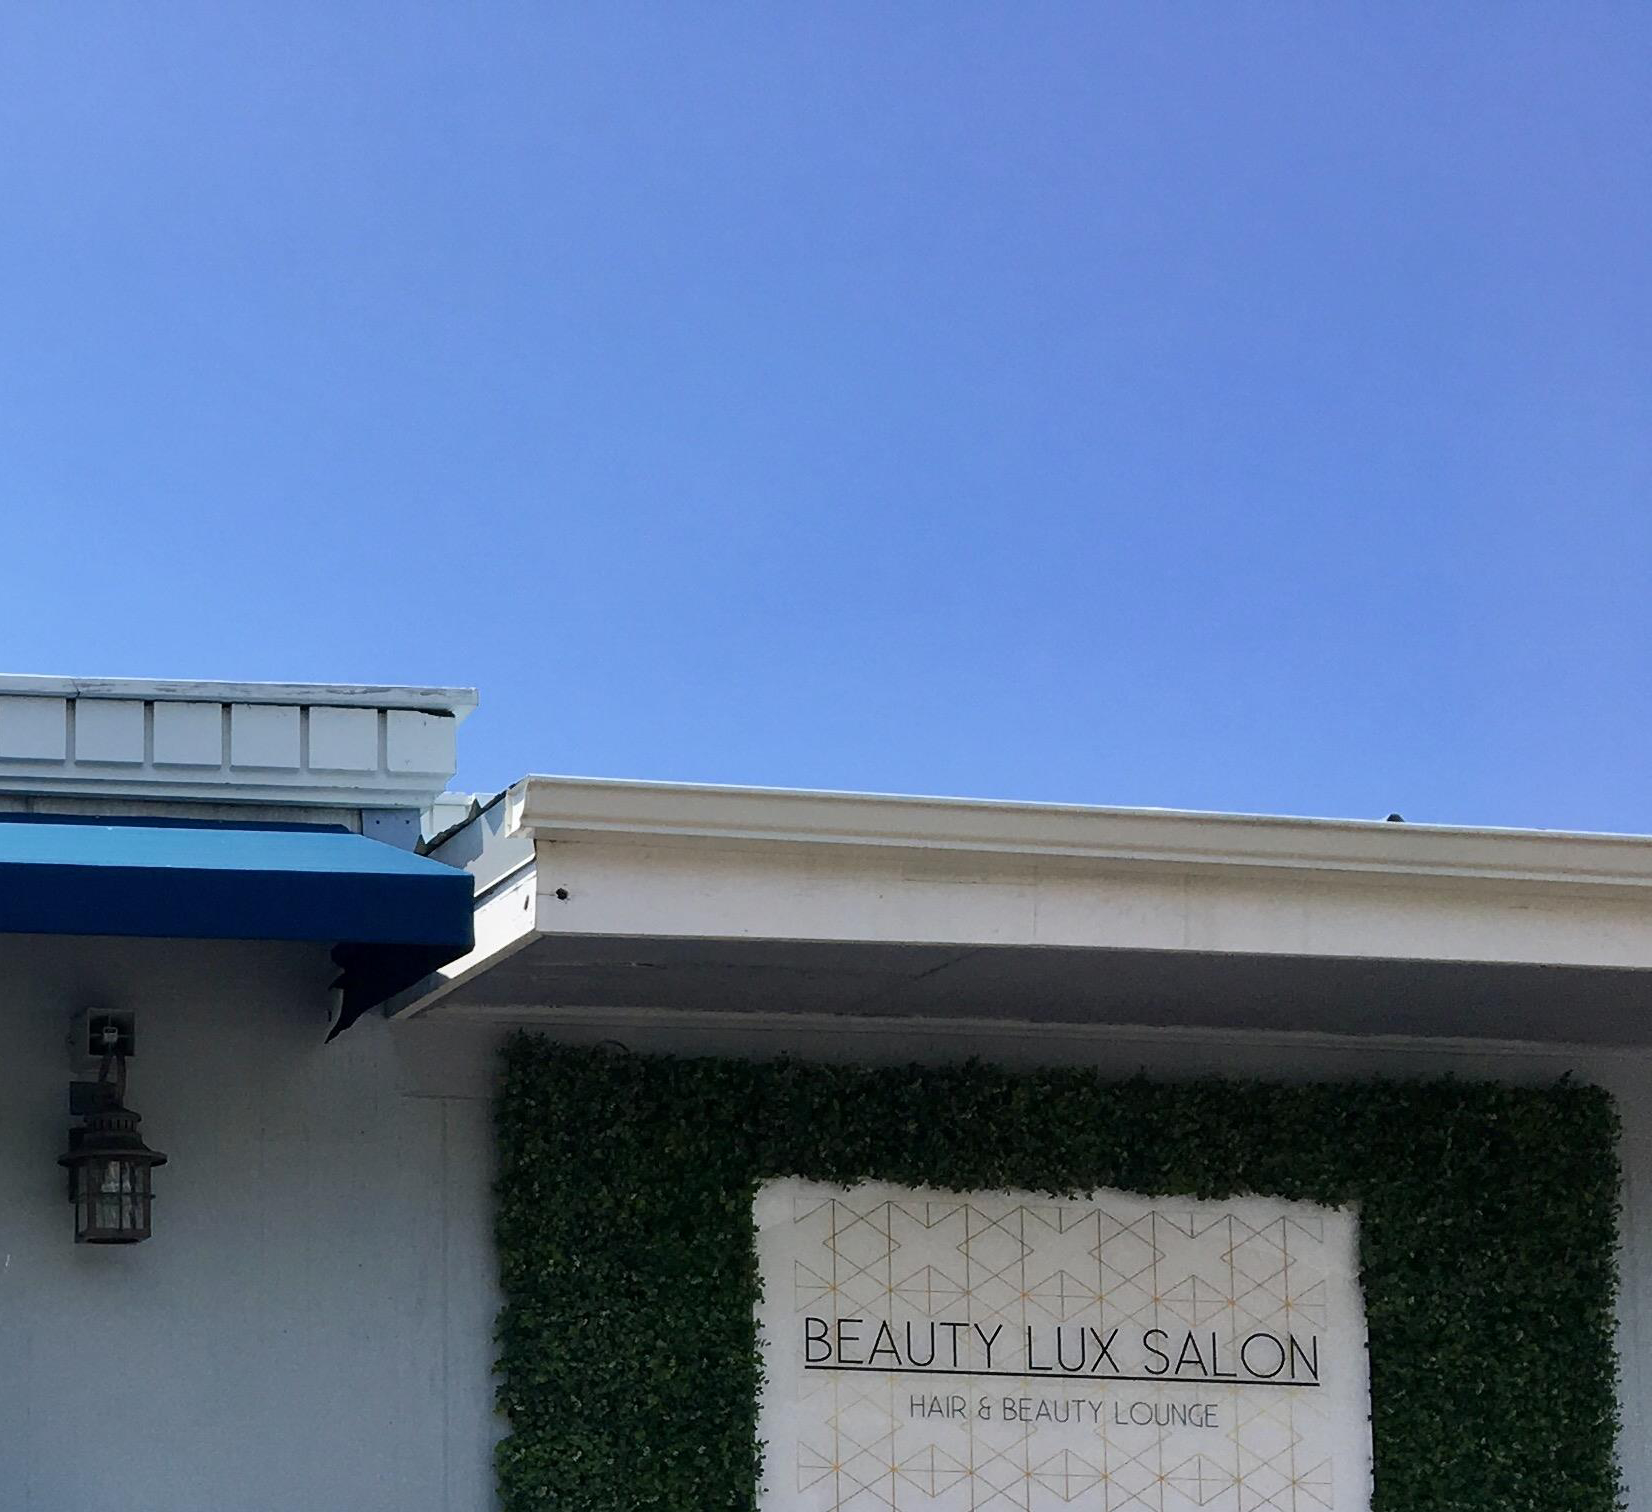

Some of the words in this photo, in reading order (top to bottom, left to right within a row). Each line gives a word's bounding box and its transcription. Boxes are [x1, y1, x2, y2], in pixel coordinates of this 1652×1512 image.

[805, 1317, 1003, 1369] BEAUTY
[1028, 1325, 1119, 1374] LUX
[1143, 1329, 1319, 1381] SALON
[910, 1394, 967, 1419] HAIR
[978, 1396, 991, 1420] &
[1003, 1397, 1103, 1424] BEAUTY
[1115, 1401, 1219, 1428] LOUNGE
